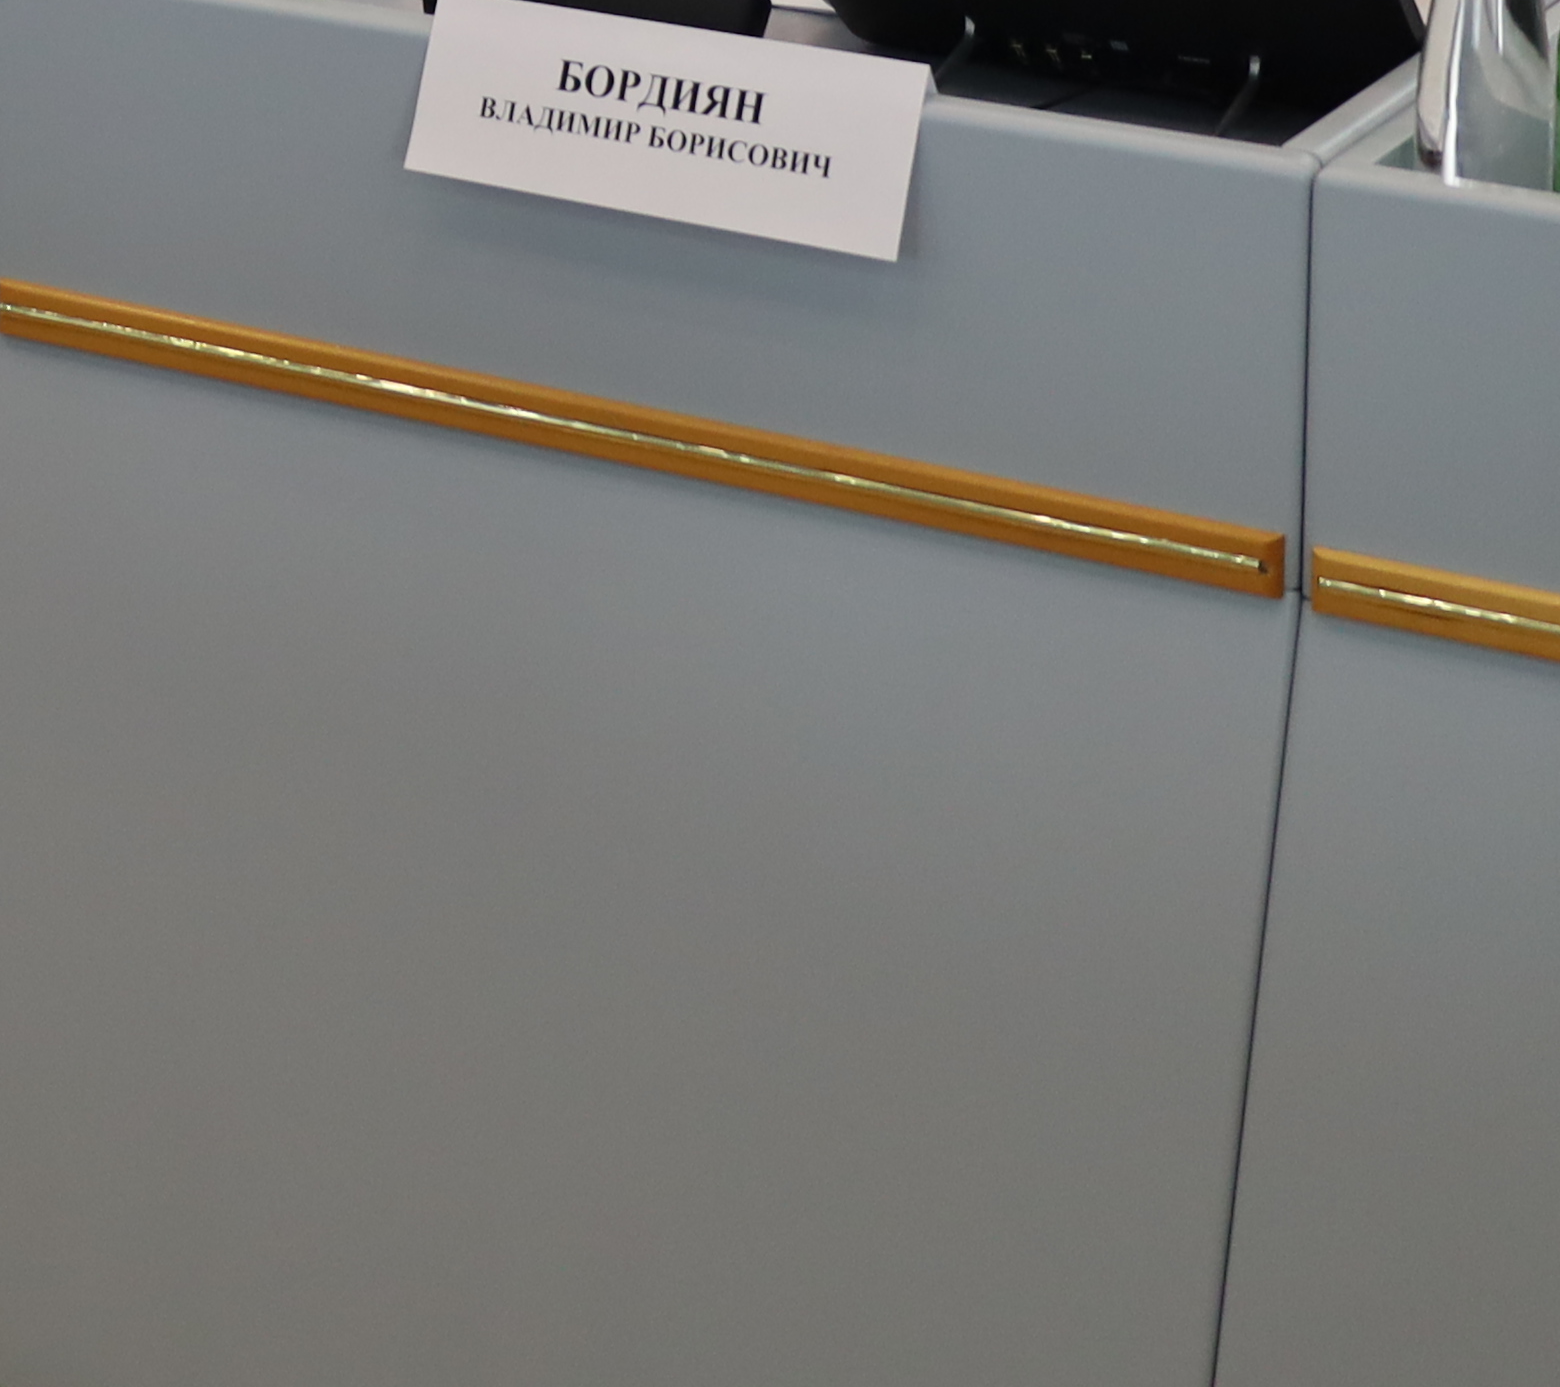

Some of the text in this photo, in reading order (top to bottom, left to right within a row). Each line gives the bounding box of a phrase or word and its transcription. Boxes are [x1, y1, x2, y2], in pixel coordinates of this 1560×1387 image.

[556, 59, 767, 125] БОРДИЯН
[479, 96, 833, 179] ВЛАДИМИР БОРИСОВИЧ
